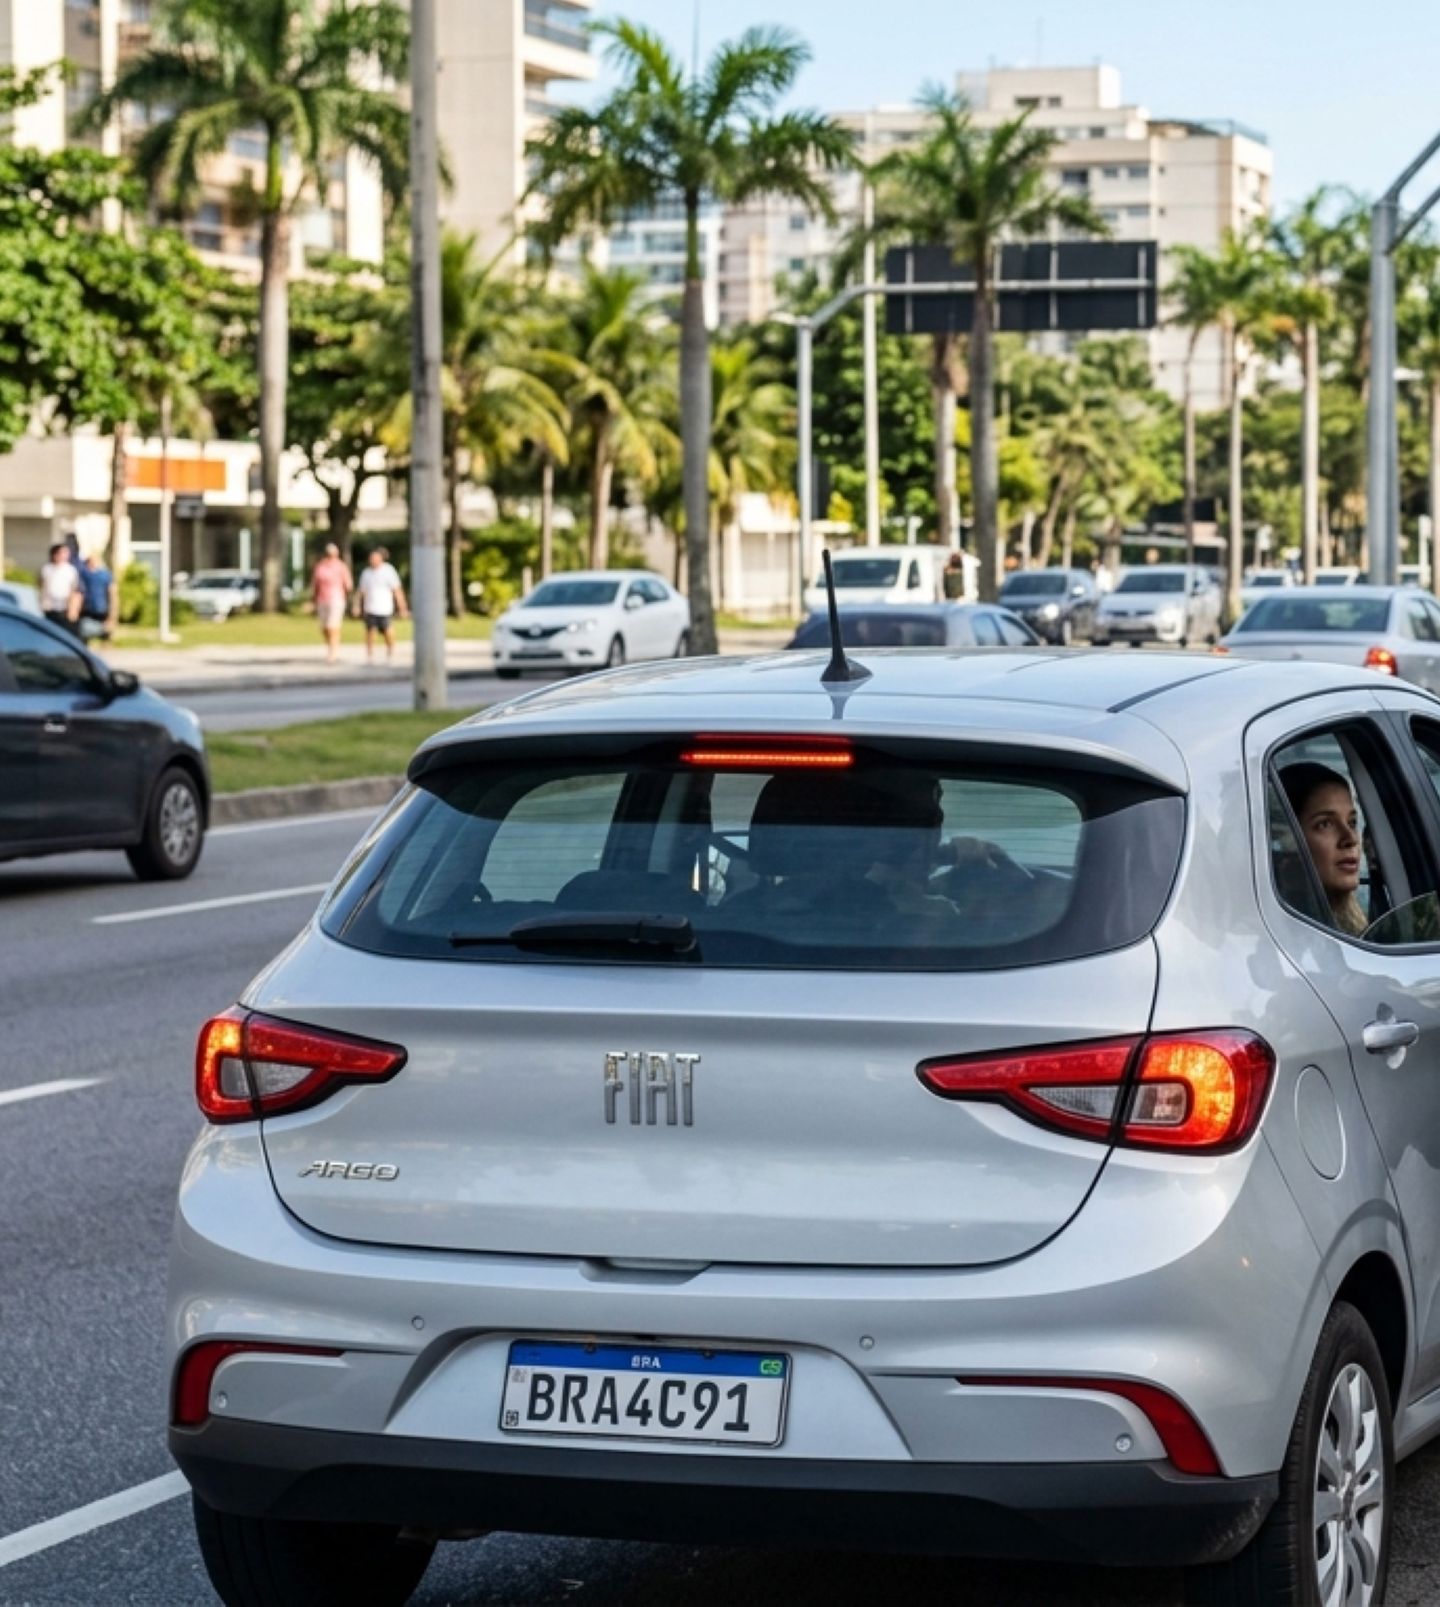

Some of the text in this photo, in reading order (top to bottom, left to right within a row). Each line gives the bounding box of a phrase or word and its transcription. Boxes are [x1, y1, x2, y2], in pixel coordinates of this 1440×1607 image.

[604, 1051, 701, 1127] FIAT
[299, 1159, 400, 1182] ARGO
[631, 1355, 662, 1369] BRA
[526, 1373, 750, 1433] BRA4C91
